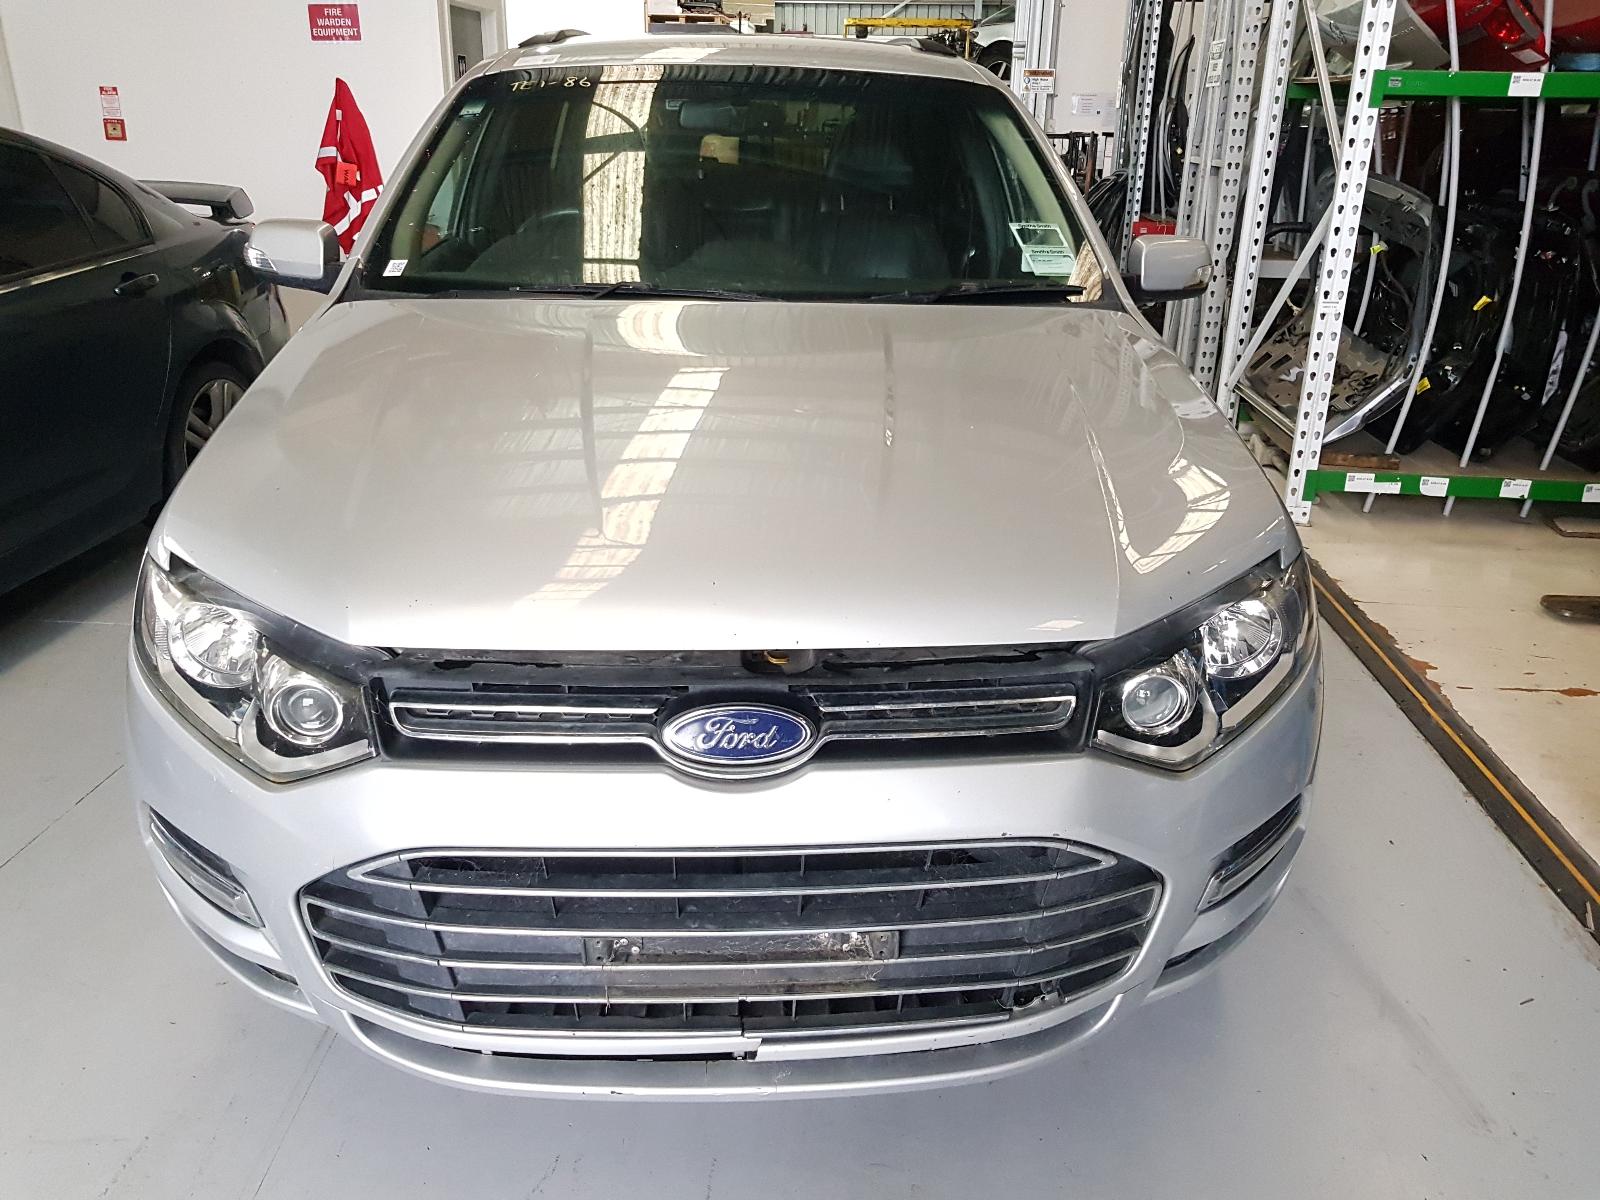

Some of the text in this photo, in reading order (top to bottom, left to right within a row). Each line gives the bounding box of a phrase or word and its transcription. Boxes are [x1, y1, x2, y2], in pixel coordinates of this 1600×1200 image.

[324, 8, 342, 16] FIRE
[317, 18, 352, 26] WARDEN
[312, 28, 358, 36] EQUIPMENT
[696, 716, 779, 750] Ford
